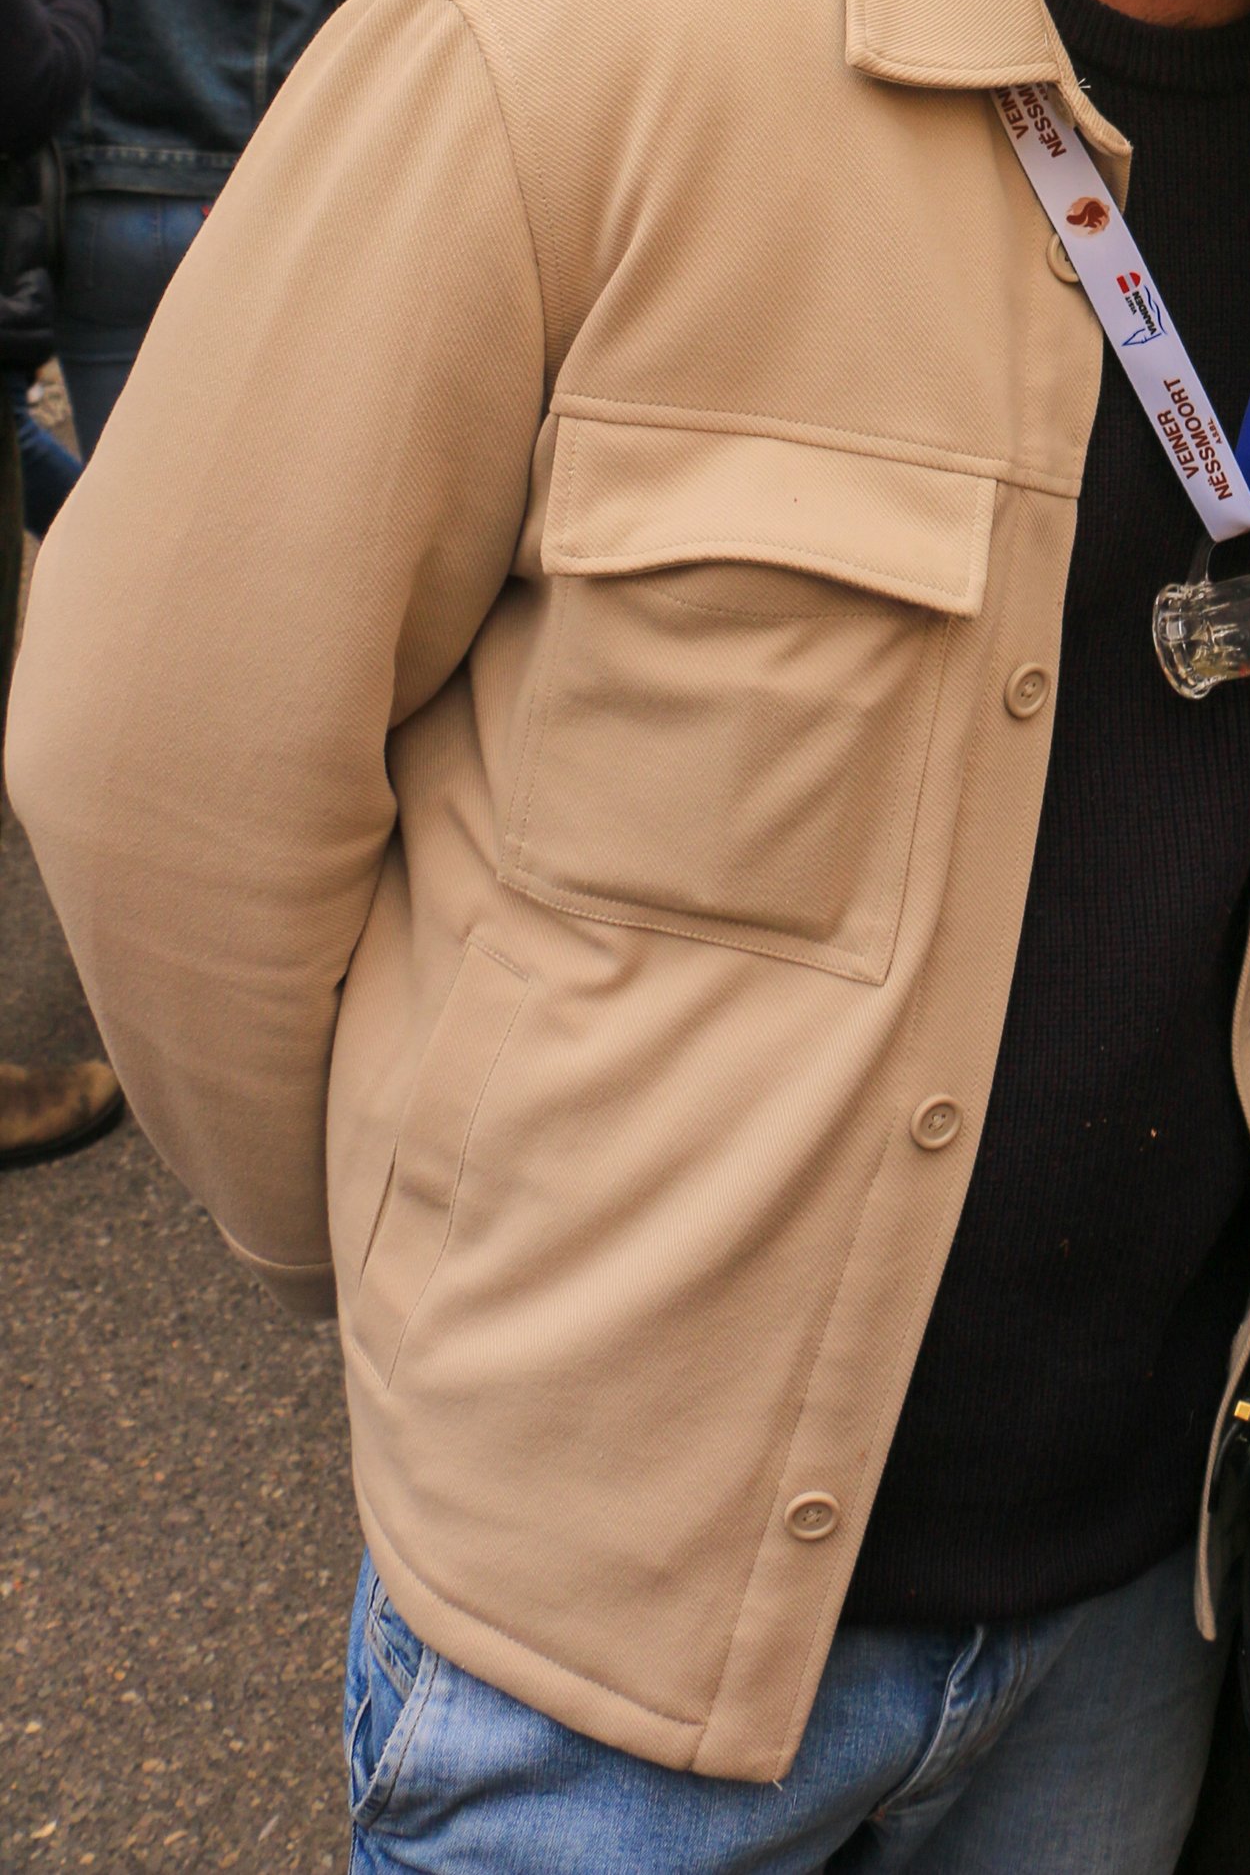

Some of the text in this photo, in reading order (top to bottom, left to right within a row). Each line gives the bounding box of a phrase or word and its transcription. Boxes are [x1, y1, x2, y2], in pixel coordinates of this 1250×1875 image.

[1132, 290, 1157, 335] VIANDEN
[1157, 409, 1199, 479] VEINER
[1163, 379, 1233, 501] NËSSMOORT
